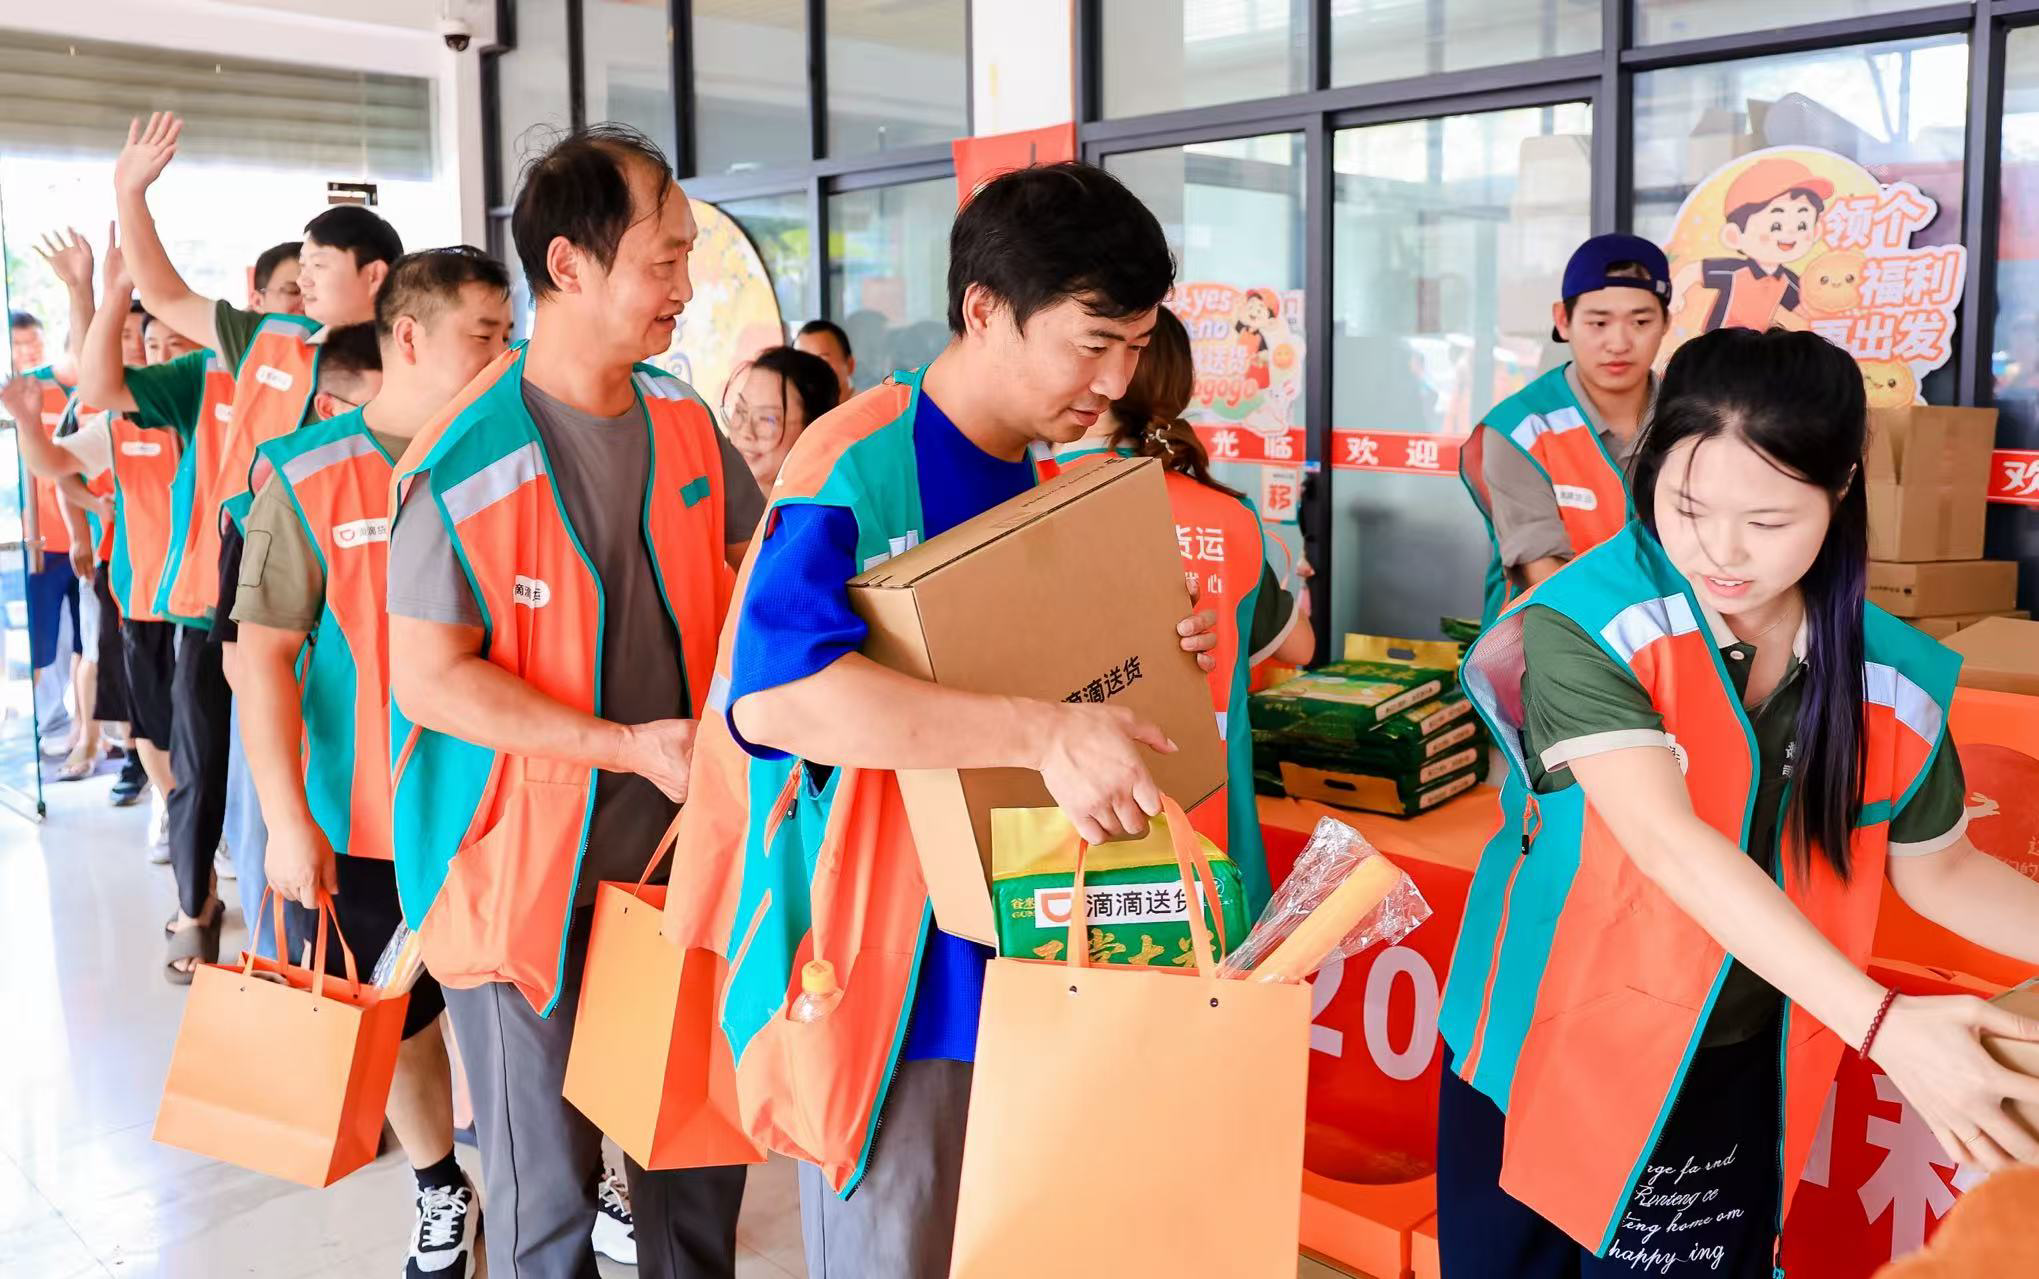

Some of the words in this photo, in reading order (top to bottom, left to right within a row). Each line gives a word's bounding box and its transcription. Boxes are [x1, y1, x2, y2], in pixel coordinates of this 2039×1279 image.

[1822, 193, 1926, 248] 领个
[1861, 253, 1955, 307] 福利
[1211, 431, 1293, 459] 光临
[1346, 437, 1440, 469] 欢迎
[2001, 460, 2039, 496] 欢
[1609, 1239, 1677, 1275] happy
[1688, 1243, 1724, 1270] ing
